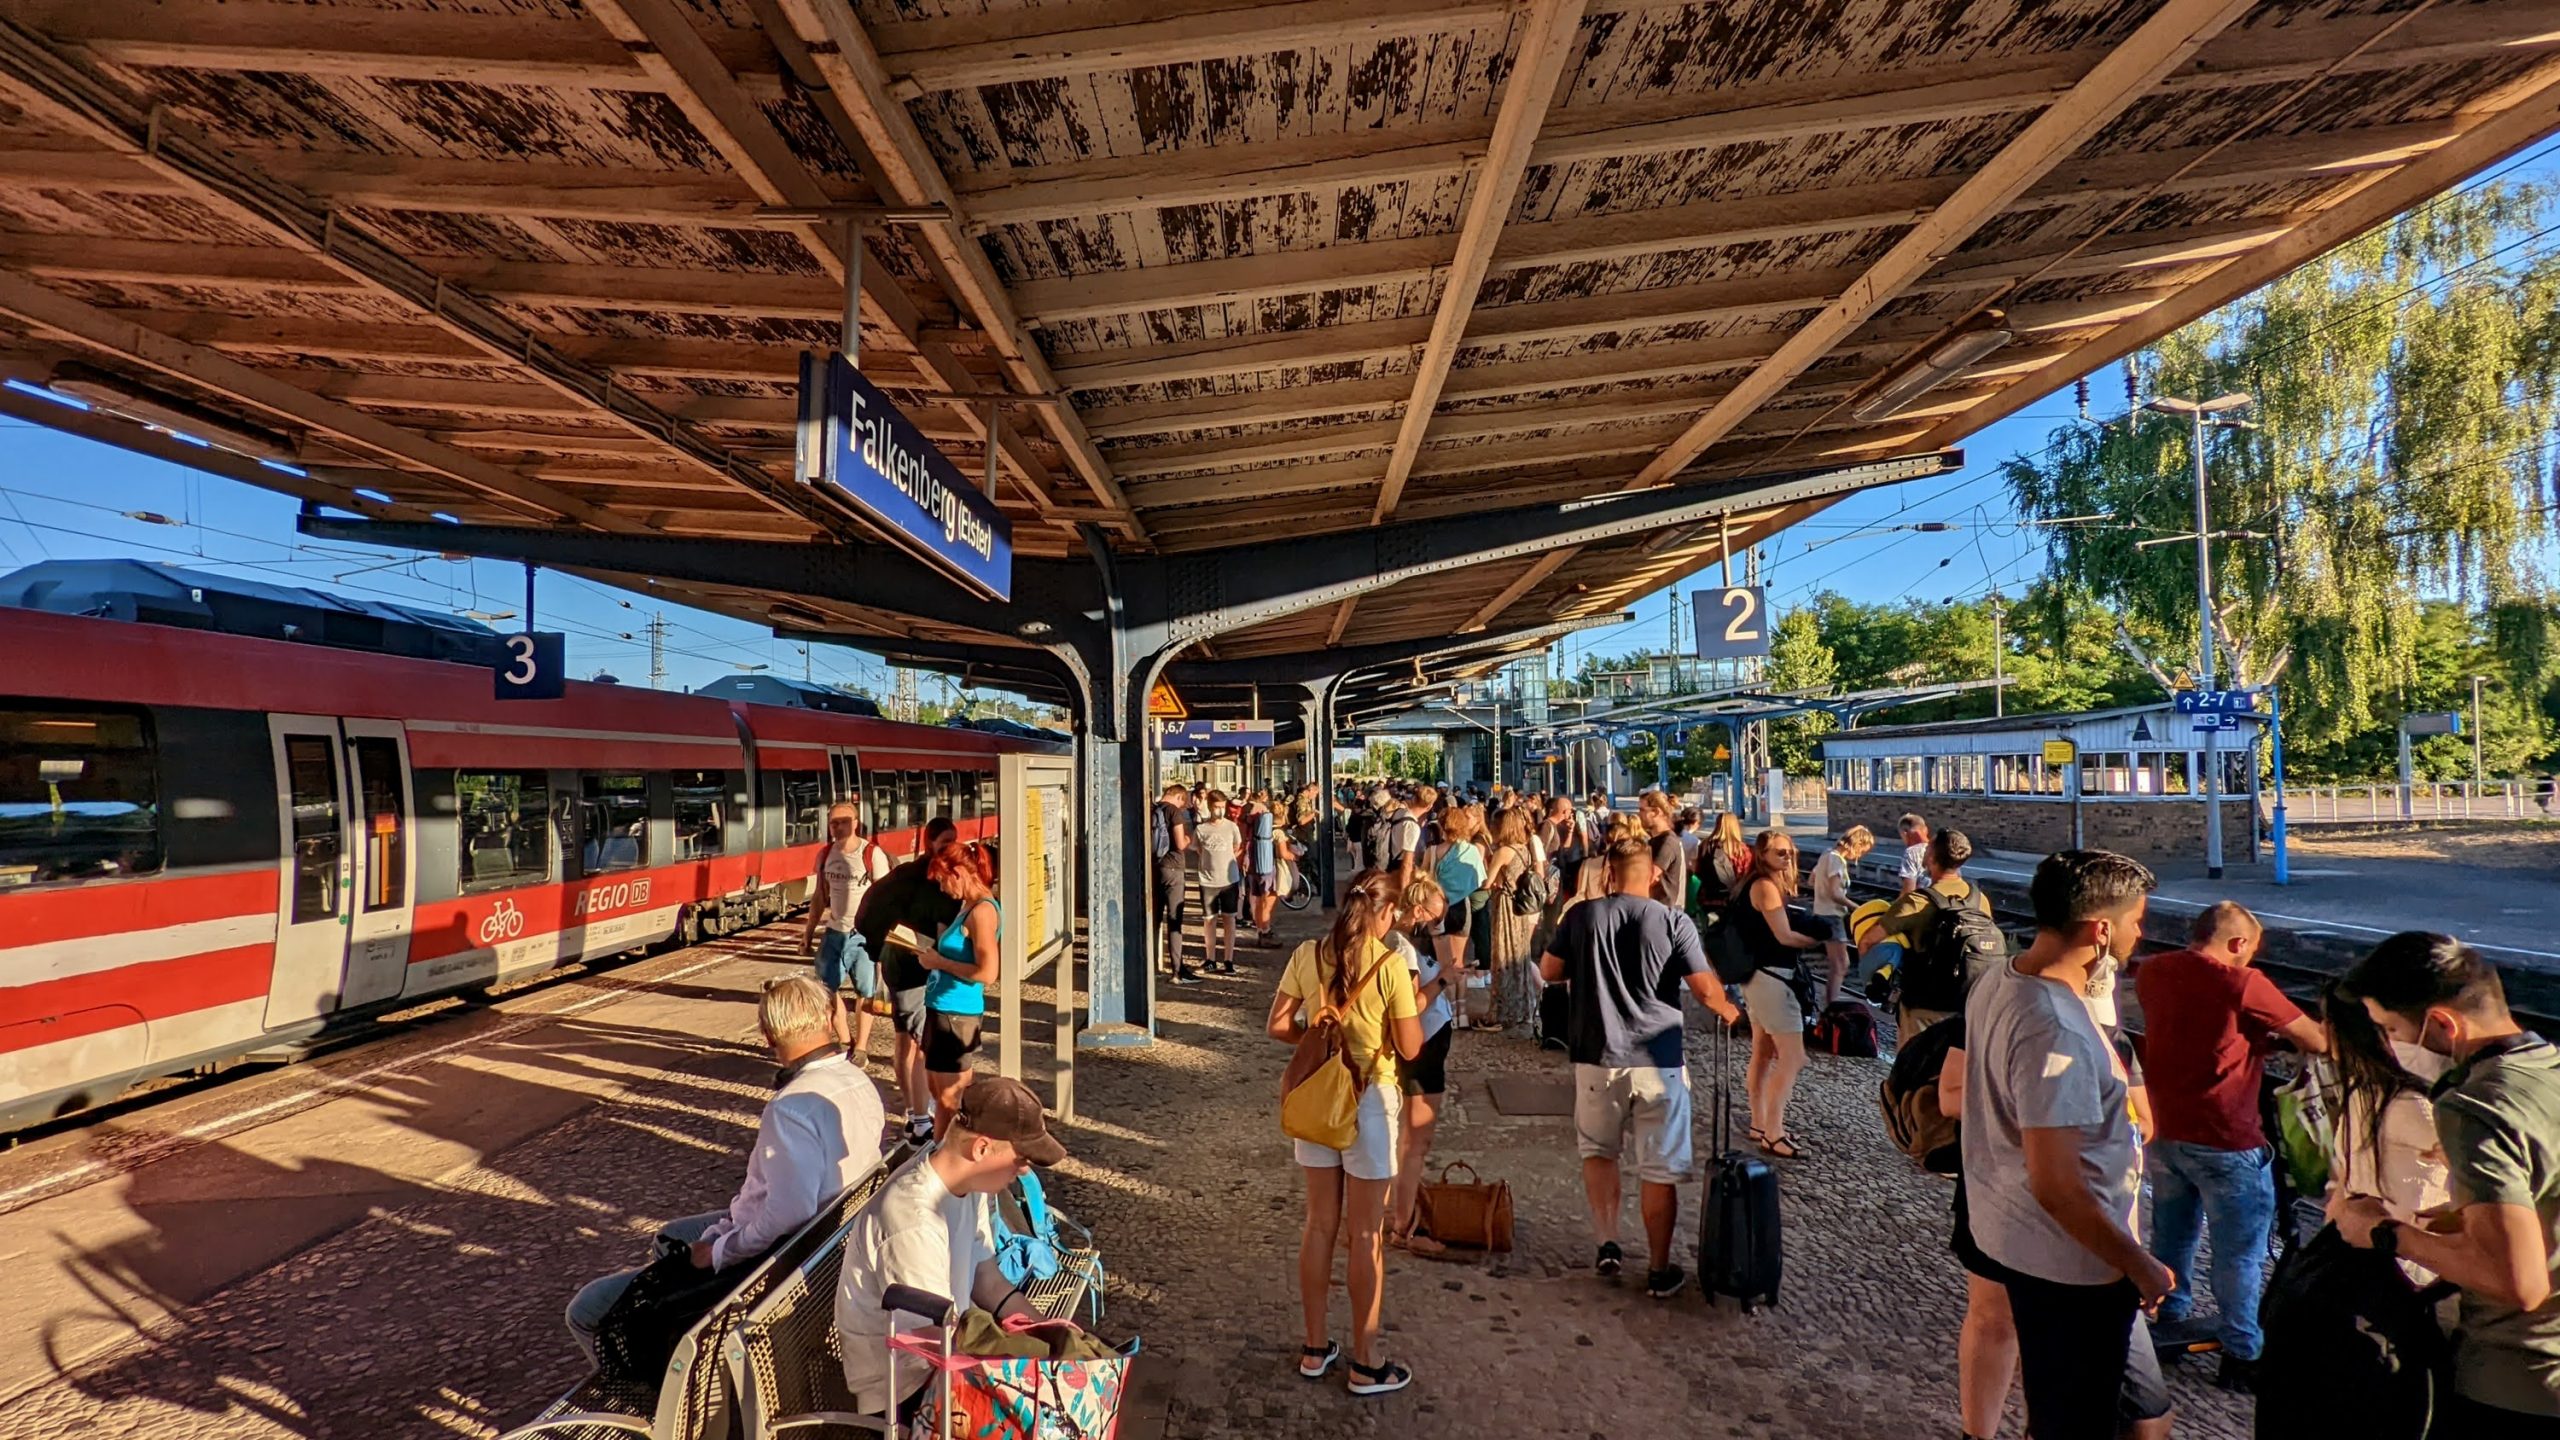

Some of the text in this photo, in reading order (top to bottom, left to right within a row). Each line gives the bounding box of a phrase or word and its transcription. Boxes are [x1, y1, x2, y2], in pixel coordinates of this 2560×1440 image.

[850, 390, 992, 562] Falkenberg (Elster)
[1722, 588, 1759, 641] 2
[504, 635, 536, 685] 3
[2198, 691, 2227, 707] 2-7
[562, 796, 571, 820] 2
[574, 881, 650, 917] REGIO DB
[1980, 941, 1996, 950] CAT
